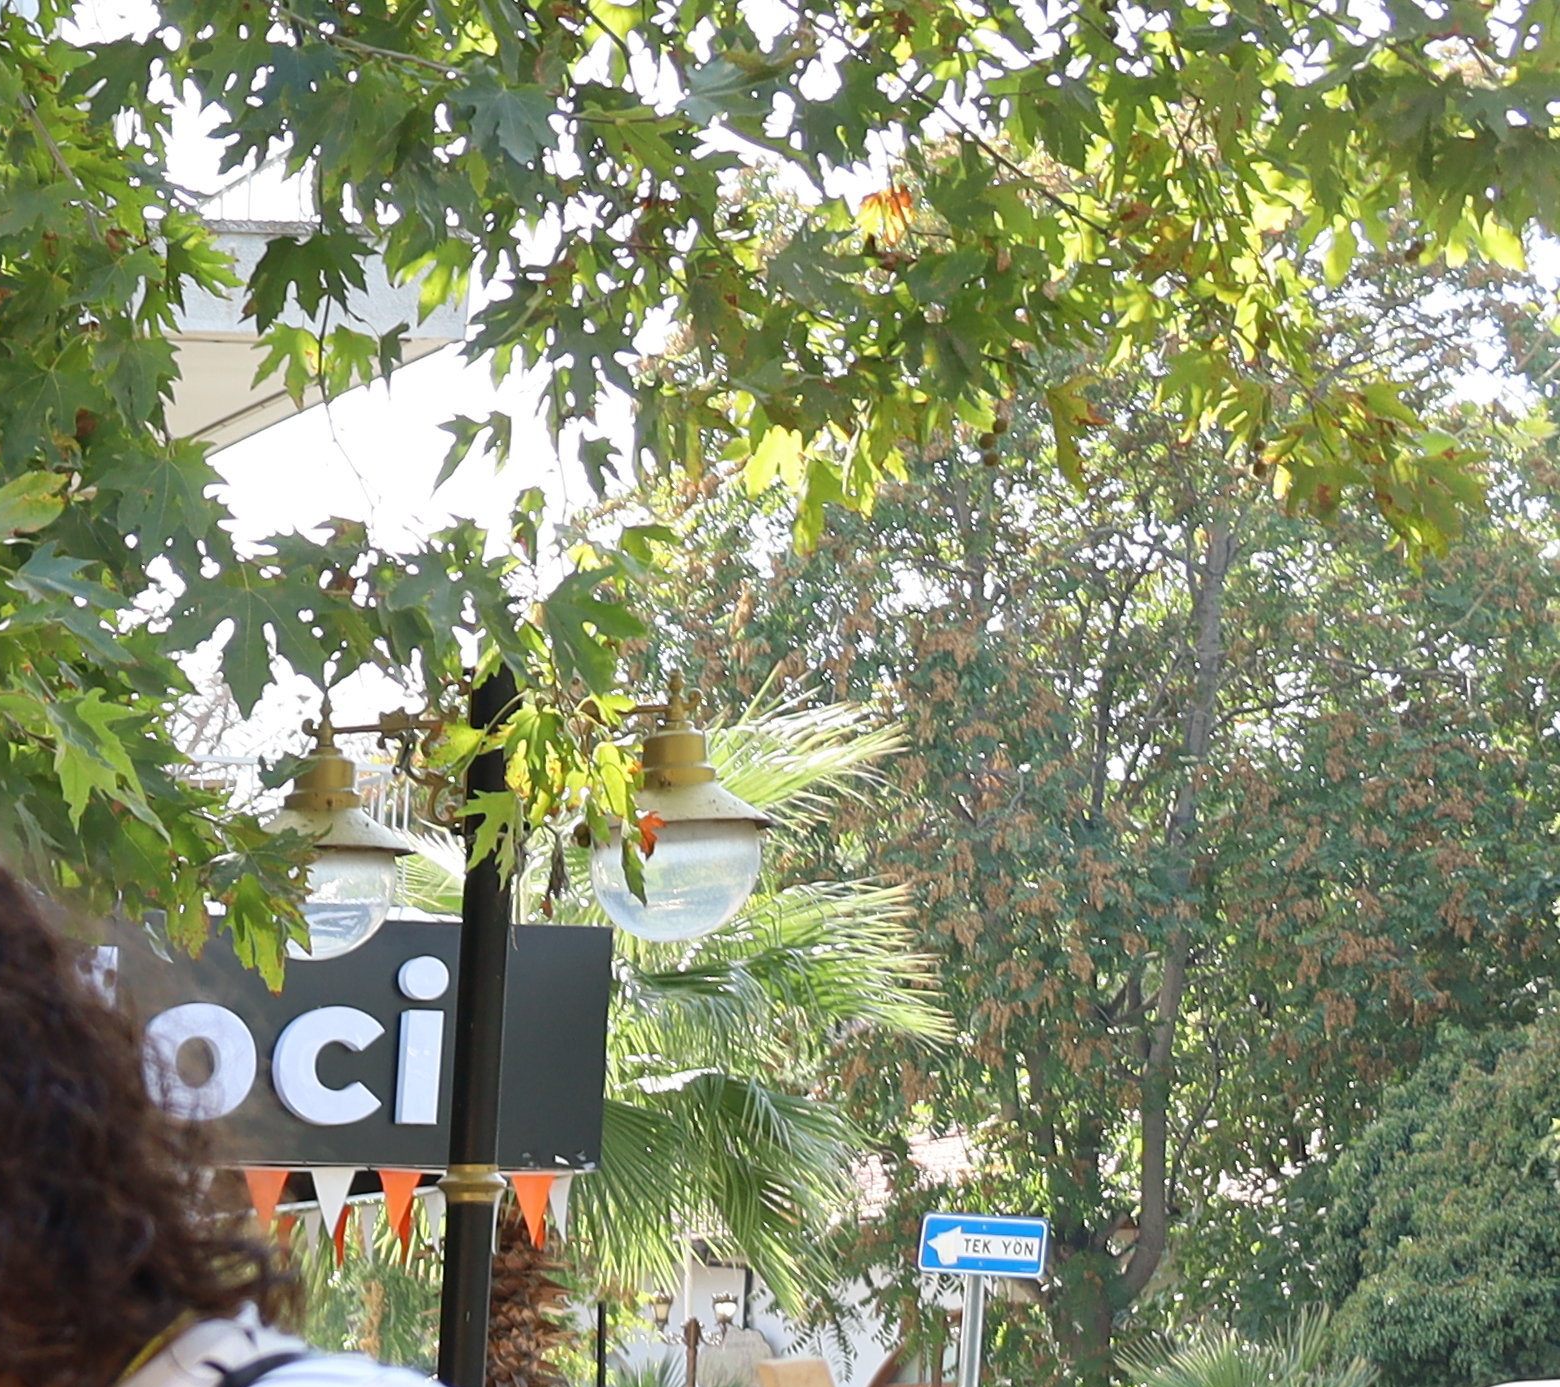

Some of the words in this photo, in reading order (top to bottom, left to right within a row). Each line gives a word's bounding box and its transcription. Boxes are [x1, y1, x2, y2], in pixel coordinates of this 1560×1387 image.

[77, 945, 451, 1127] oci
[964, 1238, 992, 1254] TEK
[1001, 1238, 1034, 1256] YÖN
